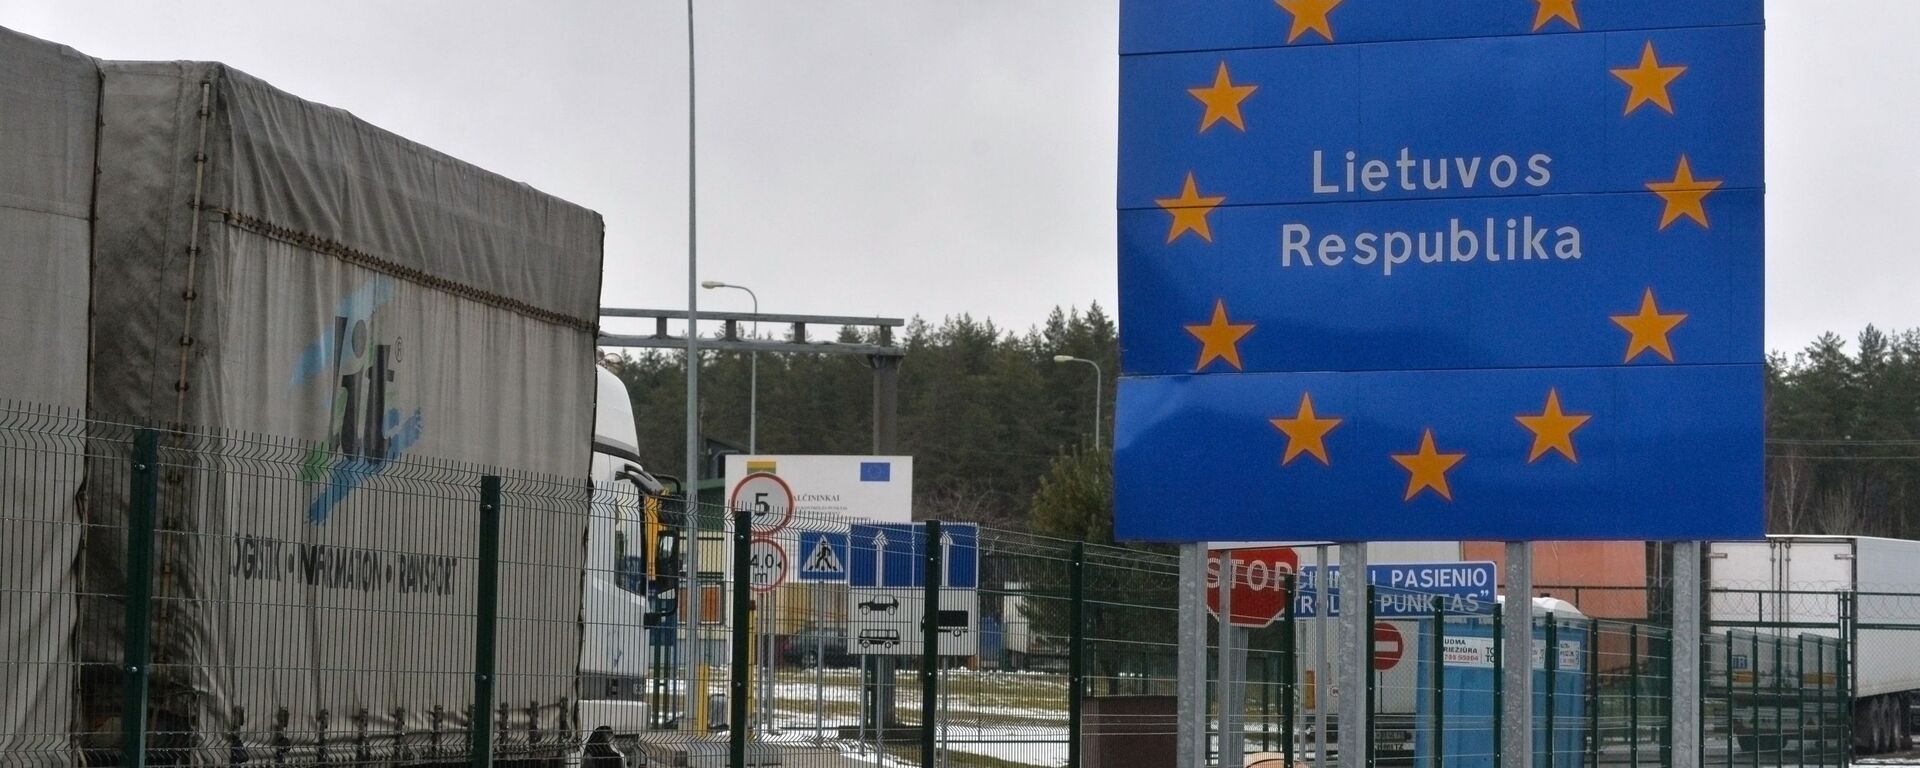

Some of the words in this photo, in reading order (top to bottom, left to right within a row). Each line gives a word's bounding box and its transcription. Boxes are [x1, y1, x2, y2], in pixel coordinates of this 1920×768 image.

[1313, 147, 1552, 193] Lietuvos
[1282, 216, 1582, 275] Respublika
[754, 493, 770, 516] 5
[1207, 557, 1293, 592] STOP
[1391, 567, 1487, 589] PASIENIO
